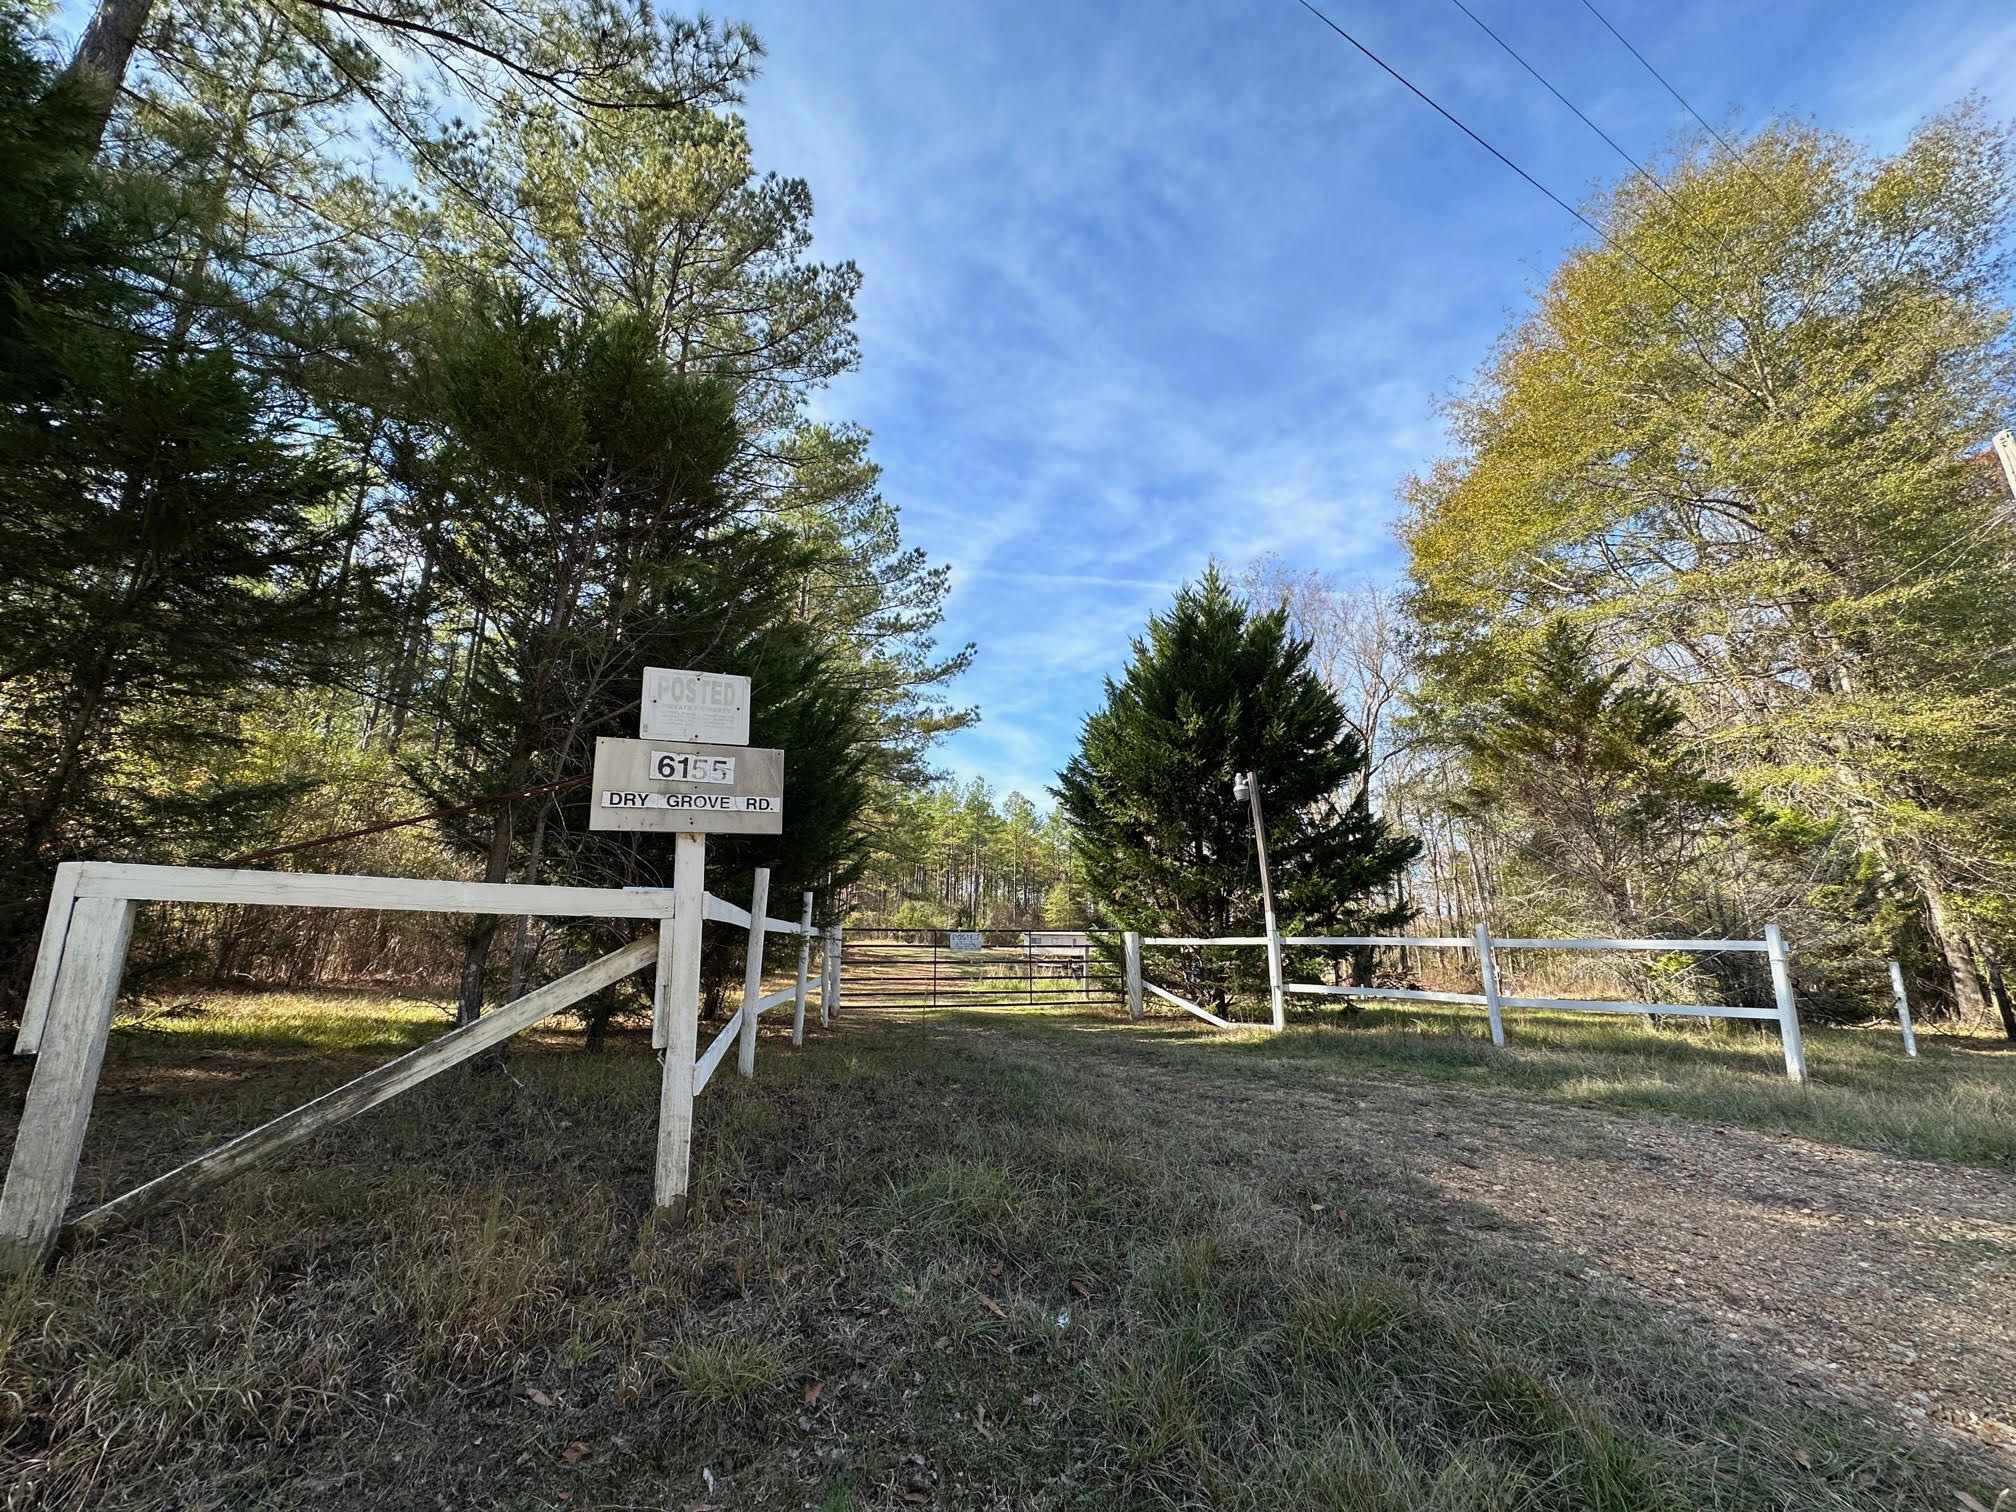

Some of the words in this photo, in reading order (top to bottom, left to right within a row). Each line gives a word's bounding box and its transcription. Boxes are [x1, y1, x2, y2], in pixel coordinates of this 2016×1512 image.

[657, 677, 736, 705] POSTED
[657, 755, 728, 781] 6155
[609, 792, 649, 806] DRY
[666, 794, 731, 809] GROVE
[745, 797, 774, 811] RD.
